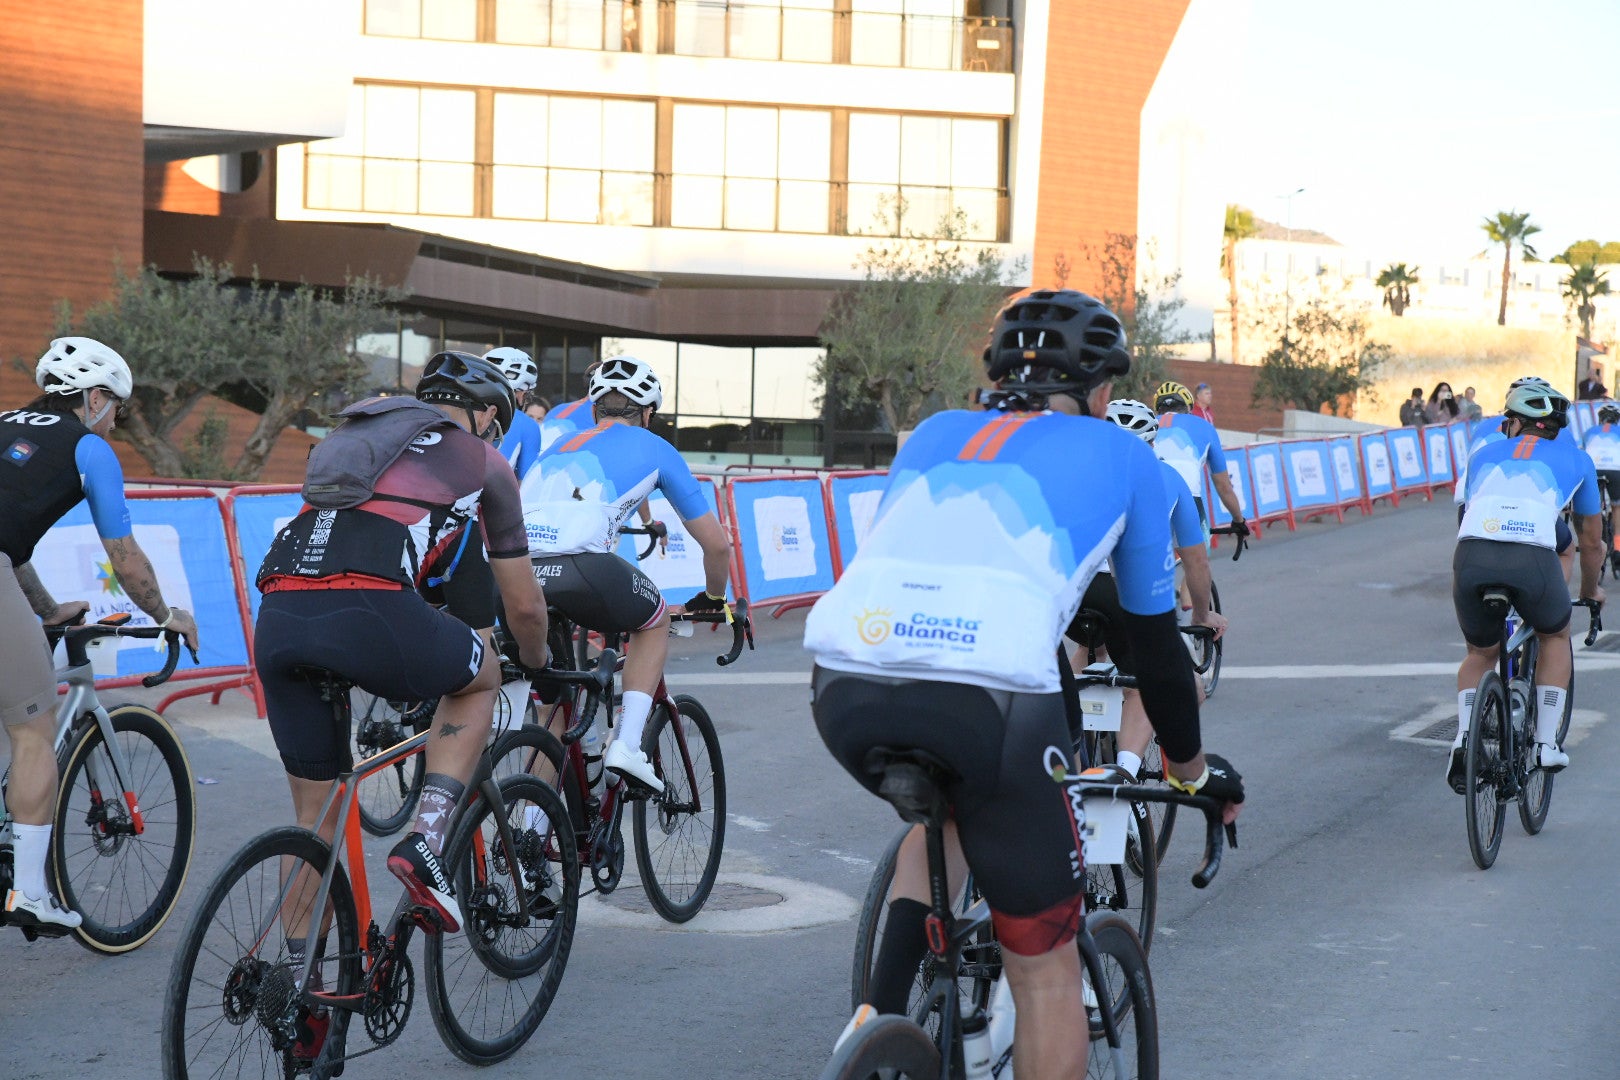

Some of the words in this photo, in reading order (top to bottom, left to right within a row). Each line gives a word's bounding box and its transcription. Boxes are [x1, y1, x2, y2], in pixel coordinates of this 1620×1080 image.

[527, 531, 558, 541] anca
[911, 612, 979, 632] Costa
[893, 621, 977, 644] Blanca
